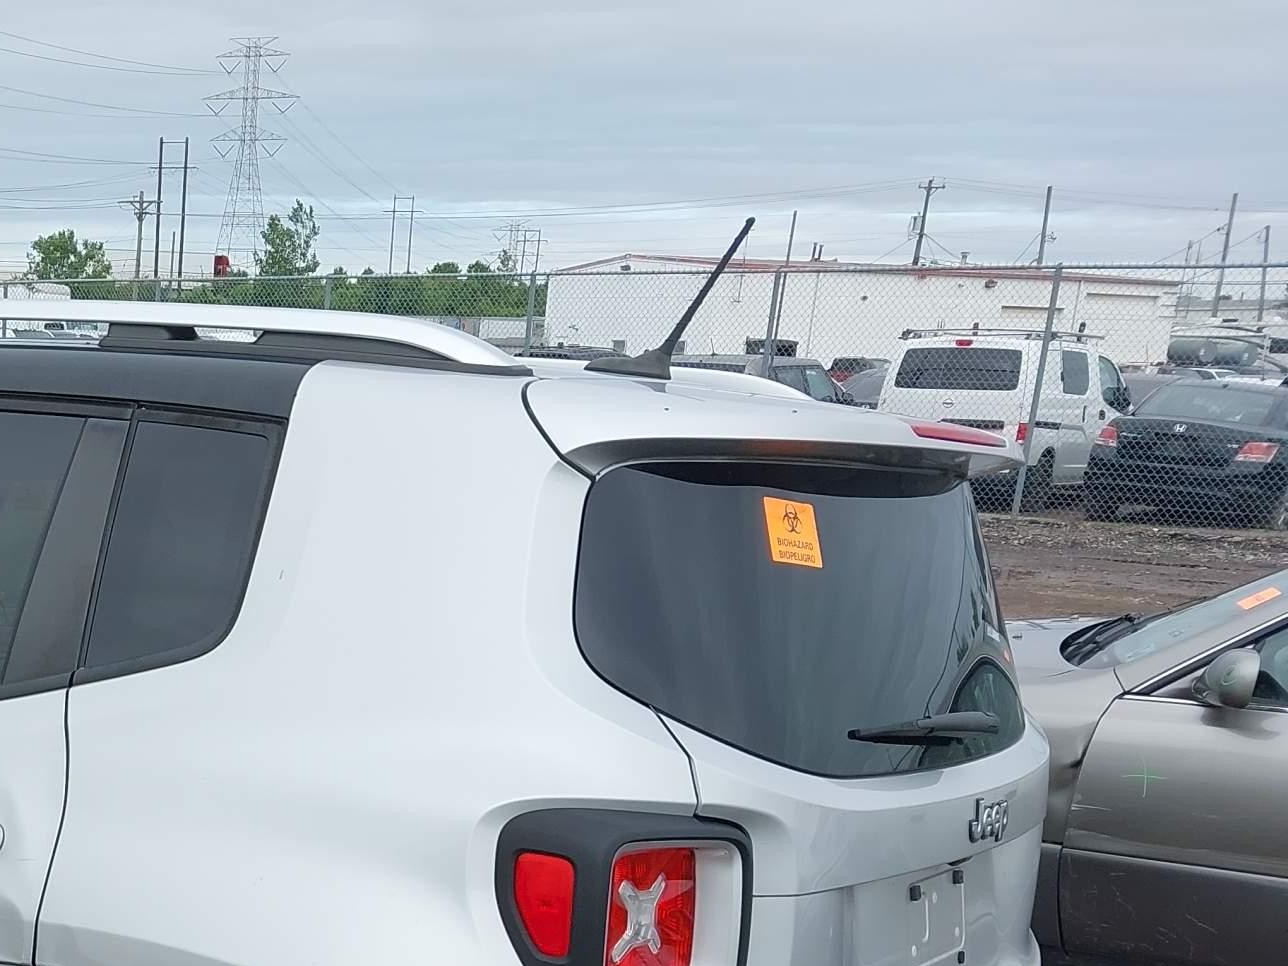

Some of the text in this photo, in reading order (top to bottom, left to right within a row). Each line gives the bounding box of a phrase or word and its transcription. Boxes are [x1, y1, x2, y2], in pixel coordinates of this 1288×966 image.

[776, 537, 814, 551] BIOHAZARD
[778, 550, 816, 564] BIOPELIGRO
[969, 797, 1008, 843] Jeep
